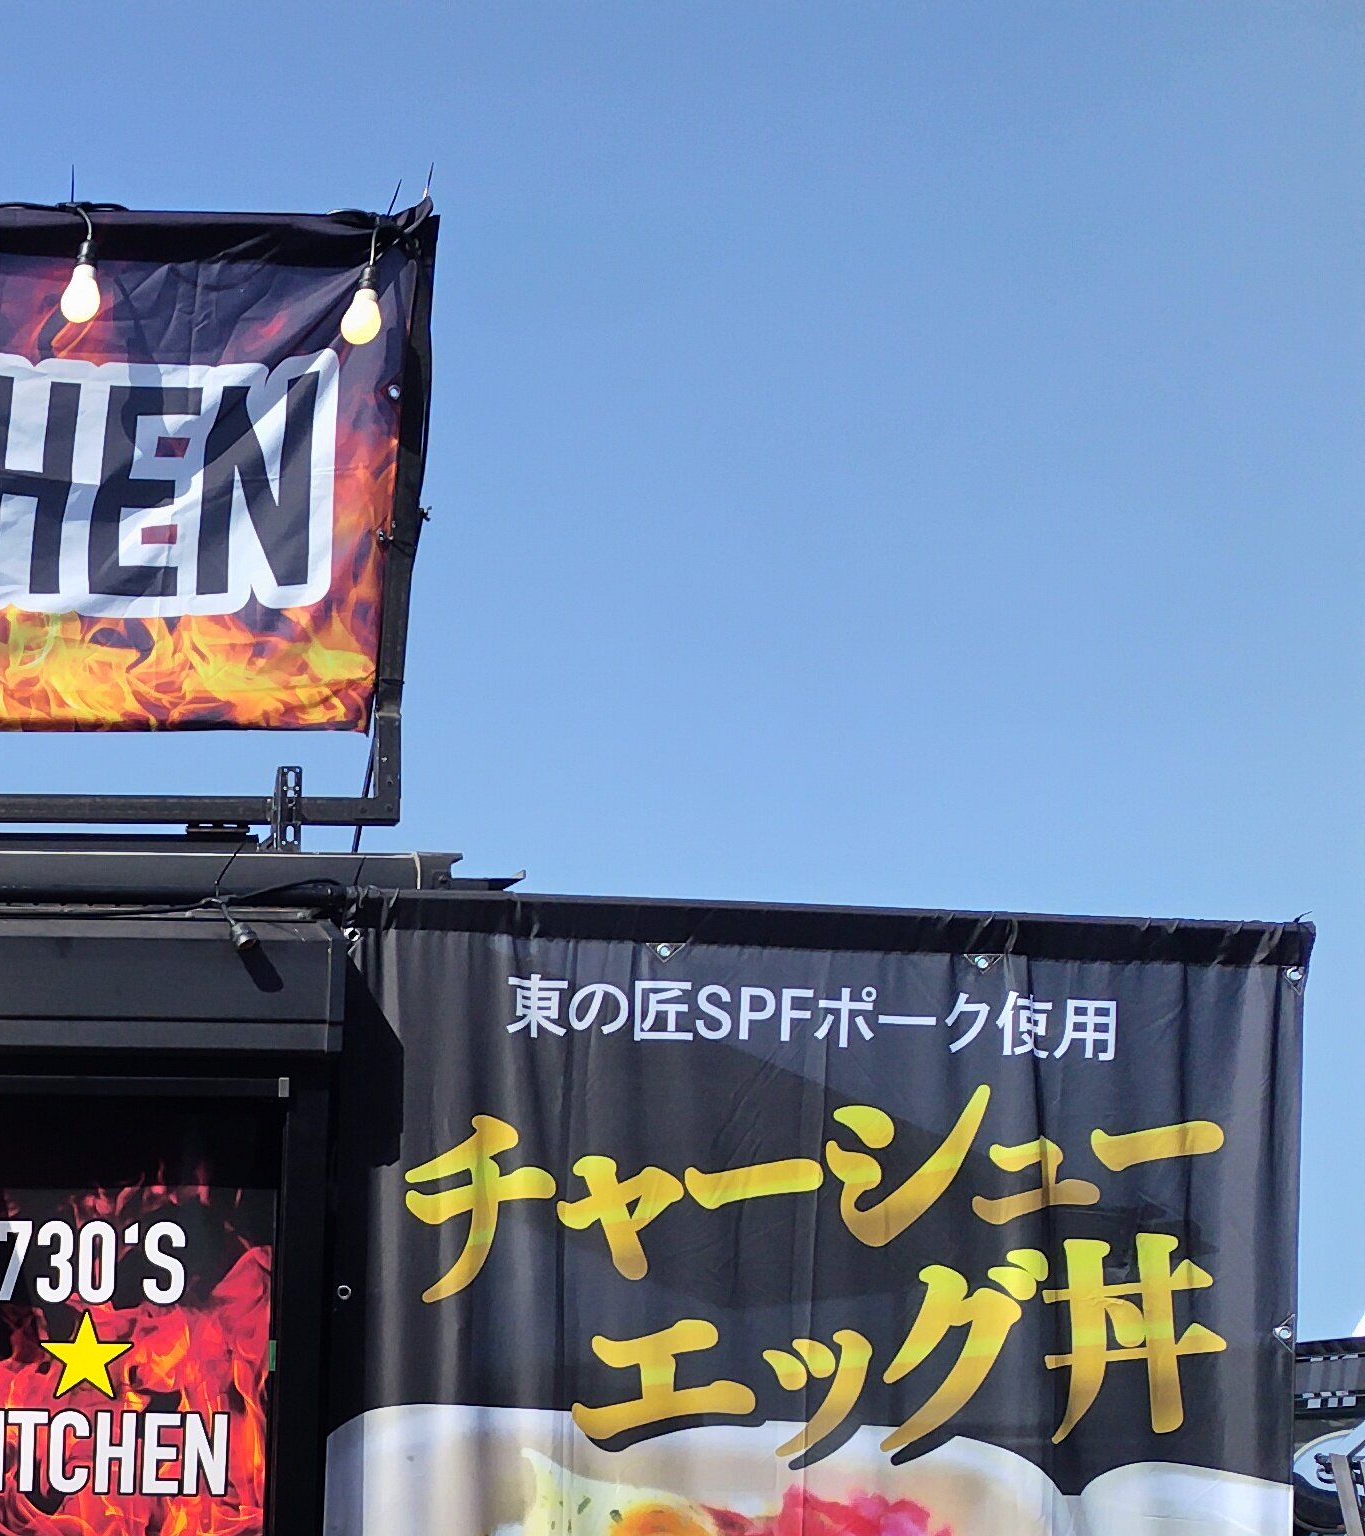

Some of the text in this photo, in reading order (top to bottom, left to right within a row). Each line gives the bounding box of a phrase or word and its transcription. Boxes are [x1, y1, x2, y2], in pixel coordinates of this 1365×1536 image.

[506, 973, 1118, 1061] 東の匠SPFポーク使用
[405, 1085, 1224, 1303] チャーシュー
[571, 1233, 1227, 1460] エッグ丼
